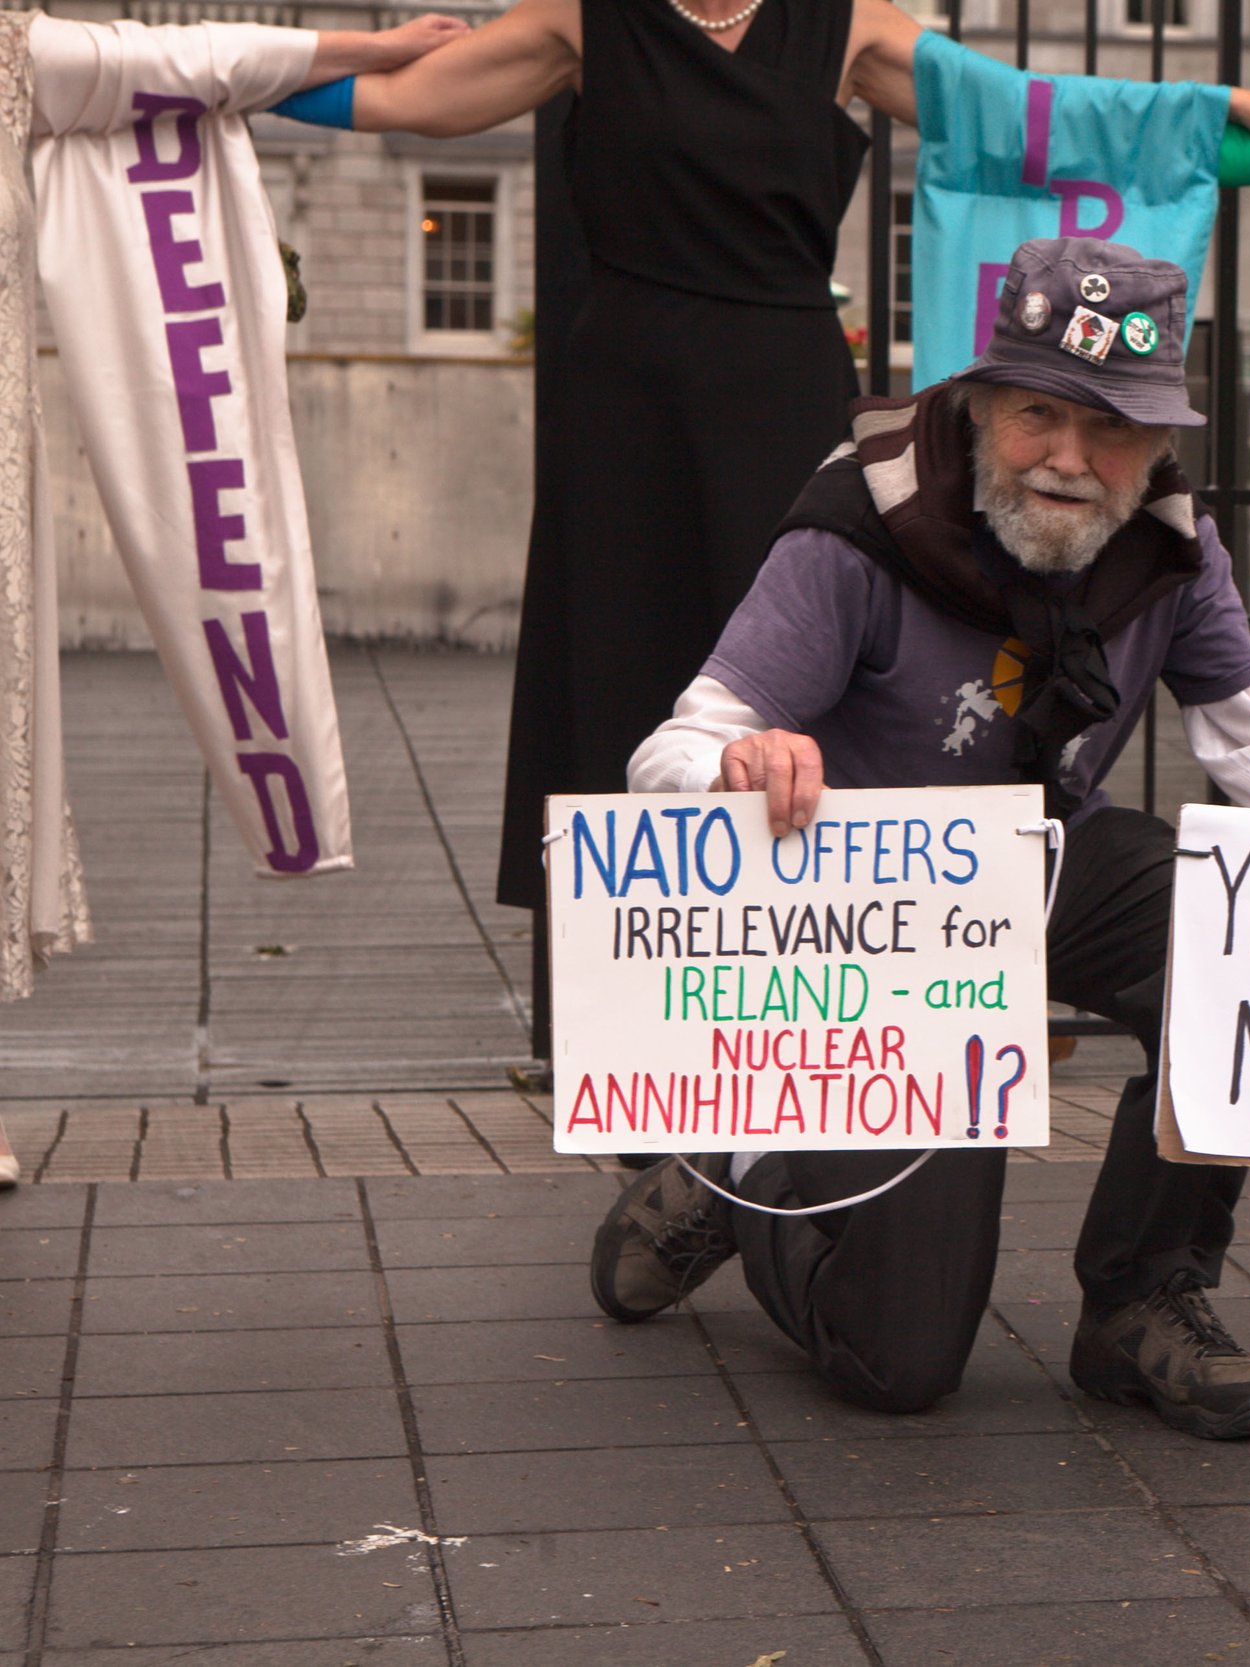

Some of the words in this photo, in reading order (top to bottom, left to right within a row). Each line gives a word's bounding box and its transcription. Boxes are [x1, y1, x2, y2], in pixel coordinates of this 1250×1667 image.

[126, 90, 321, 874] DEFEND
[572, 806, 741, 899] NATO
[771, 818, 979, 885] OFFERS
[612, 900, 918, 960] IRRELEVANCE
[940, 904, 1012, 949] for
[663, 963, 870, 1023] IRELAND
[924, 970, 1009, 1011] and
[711, 1024, 906, 1072] NUCLEAR
[566, 1071, 944, 1137] ANNIHILATION
